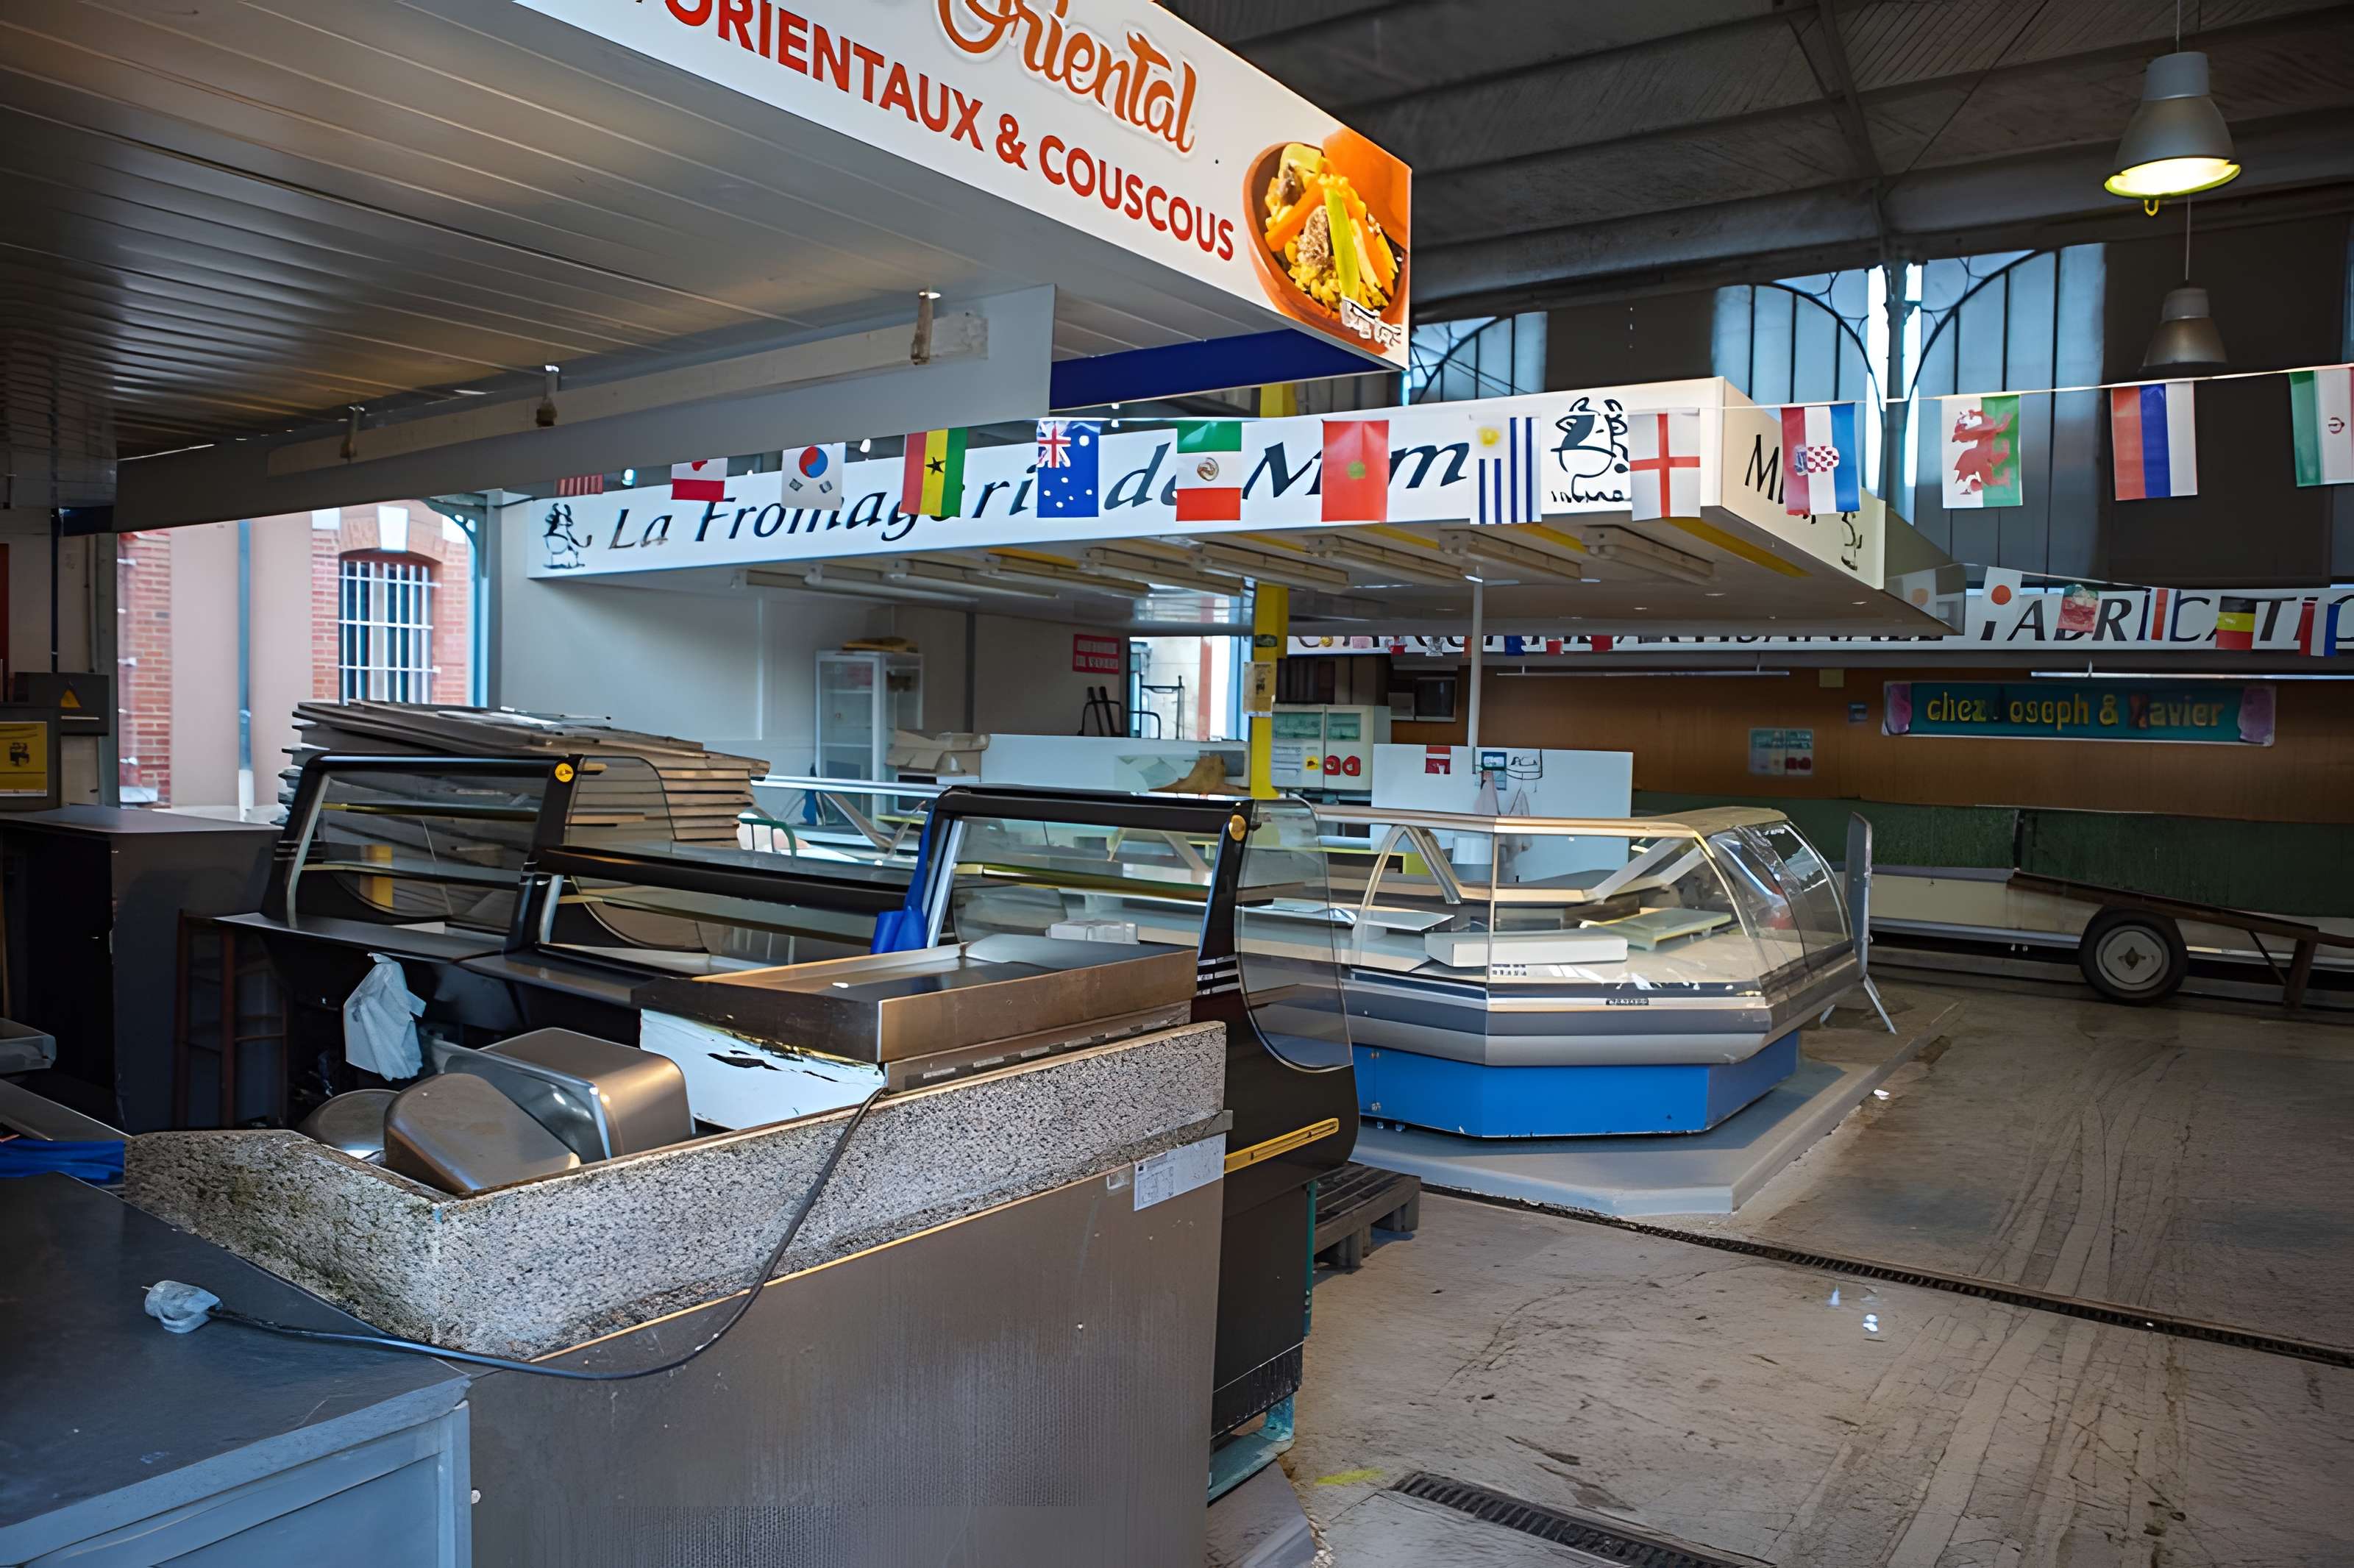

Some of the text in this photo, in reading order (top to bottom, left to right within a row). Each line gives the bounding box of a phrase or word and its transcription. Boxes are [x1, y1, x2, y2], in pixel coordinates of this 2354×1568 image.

[996, 113, 1028, 171] &
[1039, 135, 1234, 262] COUSCOUS
[608, 508, 672, 550] La
